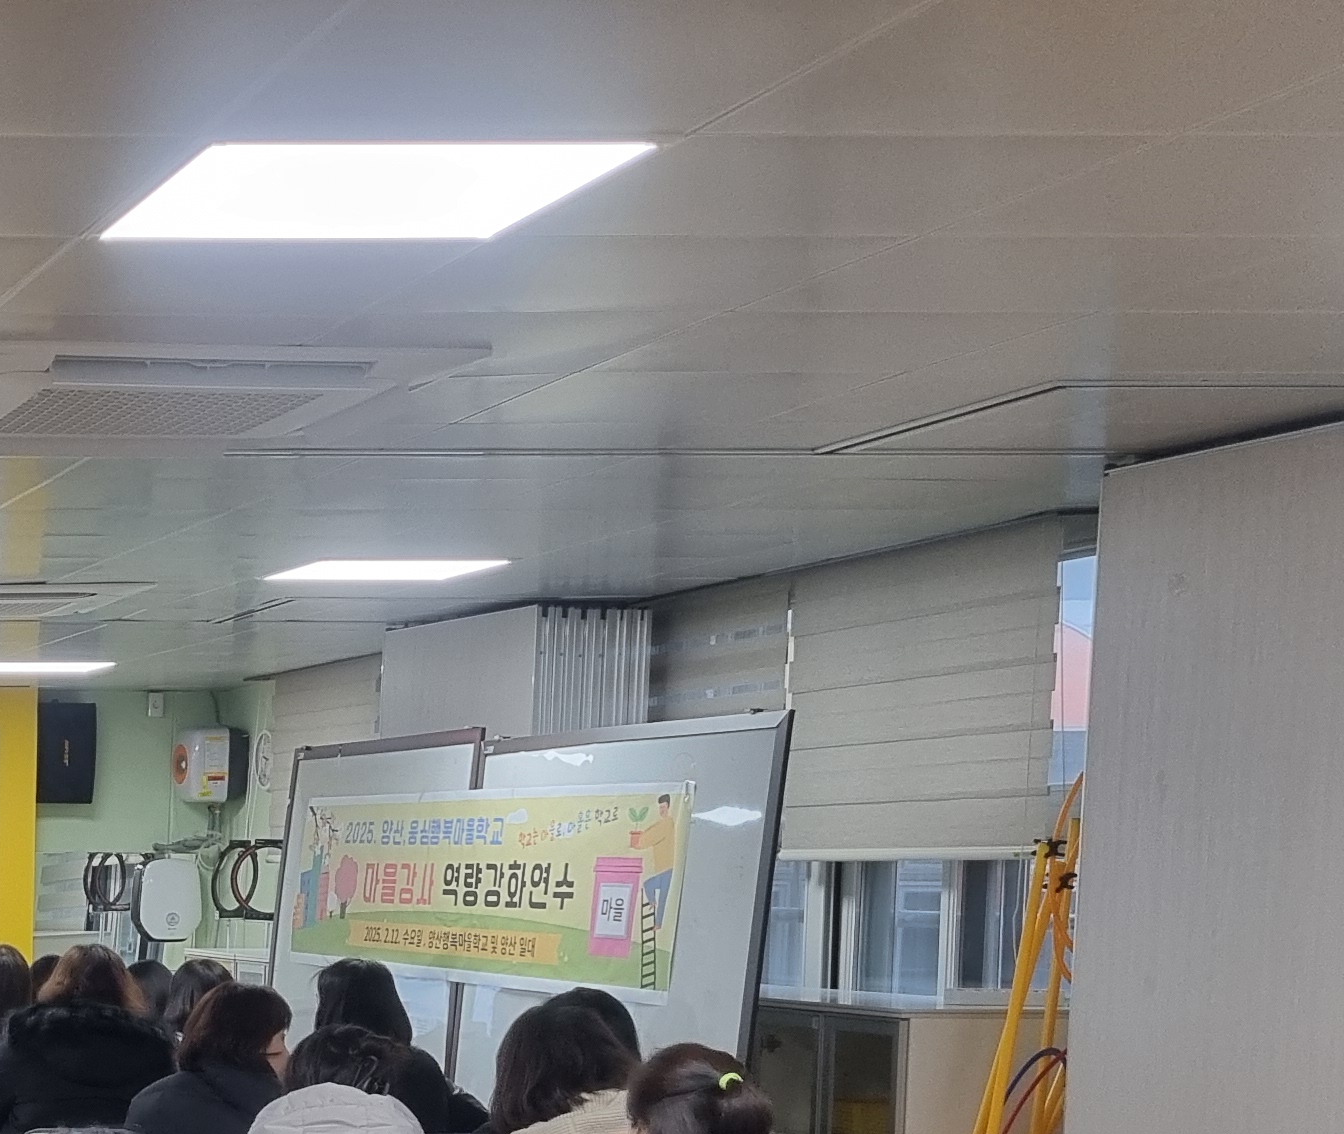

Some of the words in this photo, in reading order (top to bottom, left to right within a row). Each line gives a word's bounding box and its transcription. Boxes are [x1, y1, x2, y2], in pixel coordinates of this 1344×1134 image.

[345, 821, 377, 845] 2025.
[363, 862, 435, 905] 마을강사
[442, 859, 575, 910] 역량강화연수
[601, 897, 625, 922] 마을
[428, 930, 488, 953] 양산행복마을학교
[490, 934, 499, 955] 및
[500, 935, 517, 956] 양산
[519, 937, 537, 958] 일대
